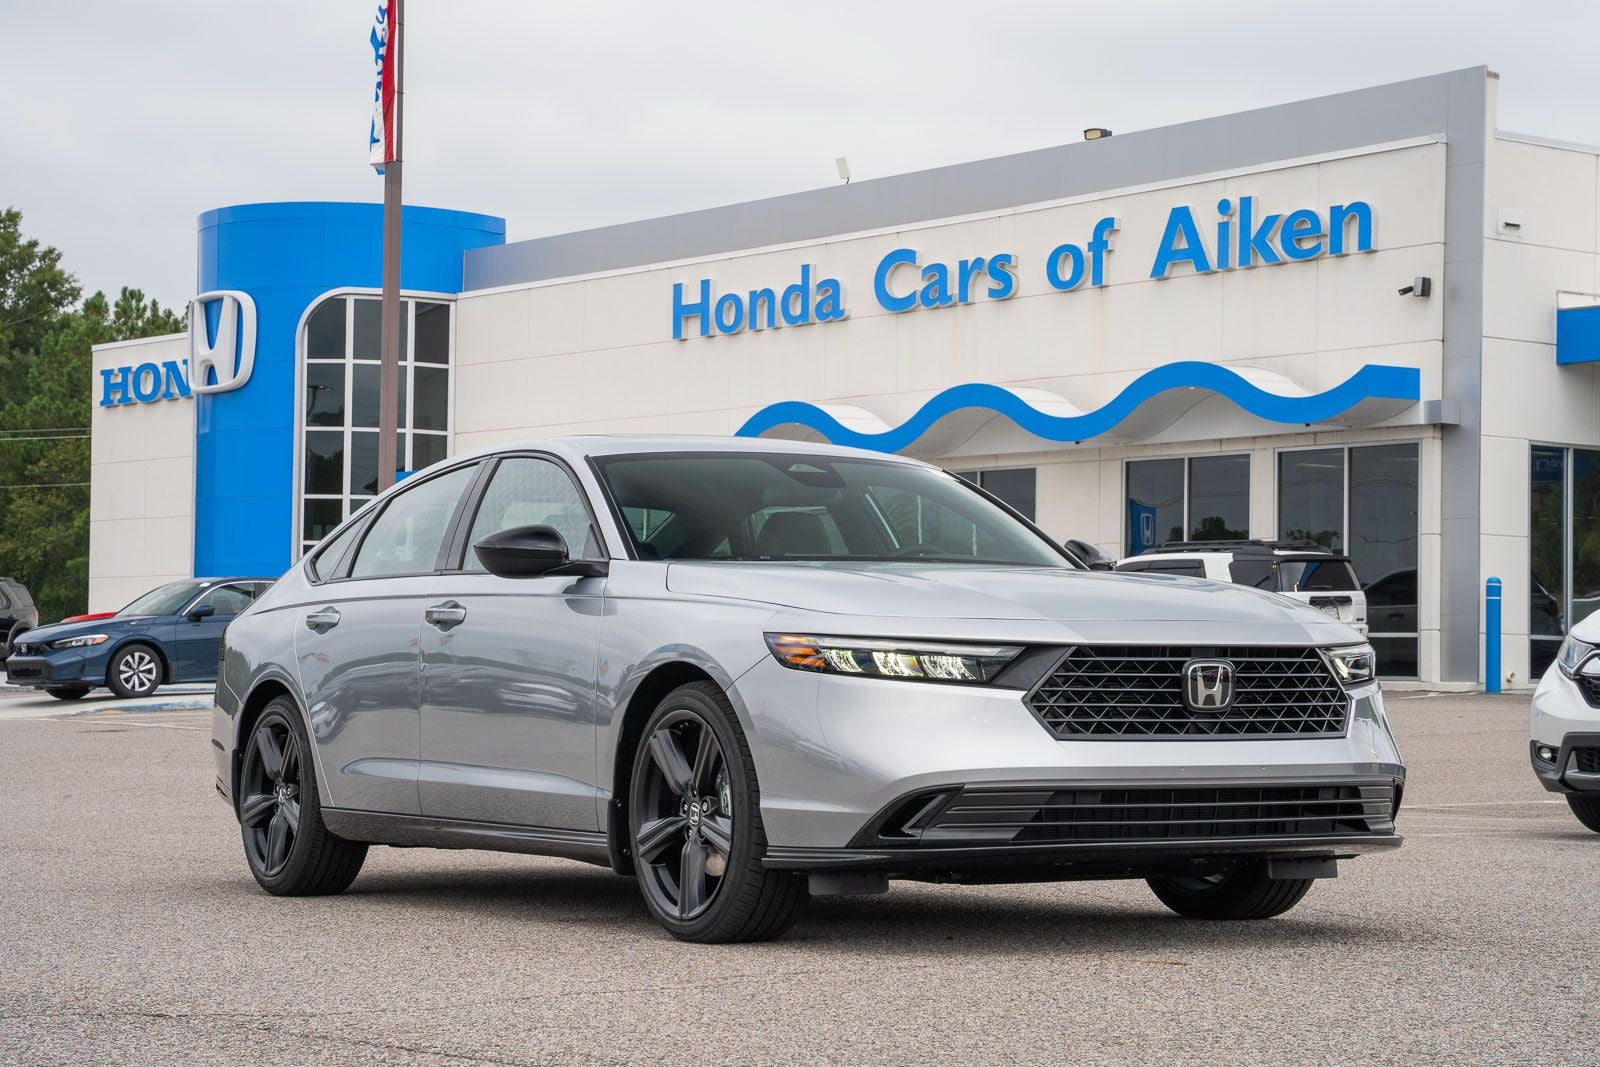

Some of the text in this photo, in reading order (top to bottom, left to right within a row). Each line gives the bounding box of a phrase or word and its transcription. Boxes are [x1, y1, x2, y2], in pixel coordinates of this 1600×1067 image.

[672, 195, 1375, 340] Honda Cars of Aiken
